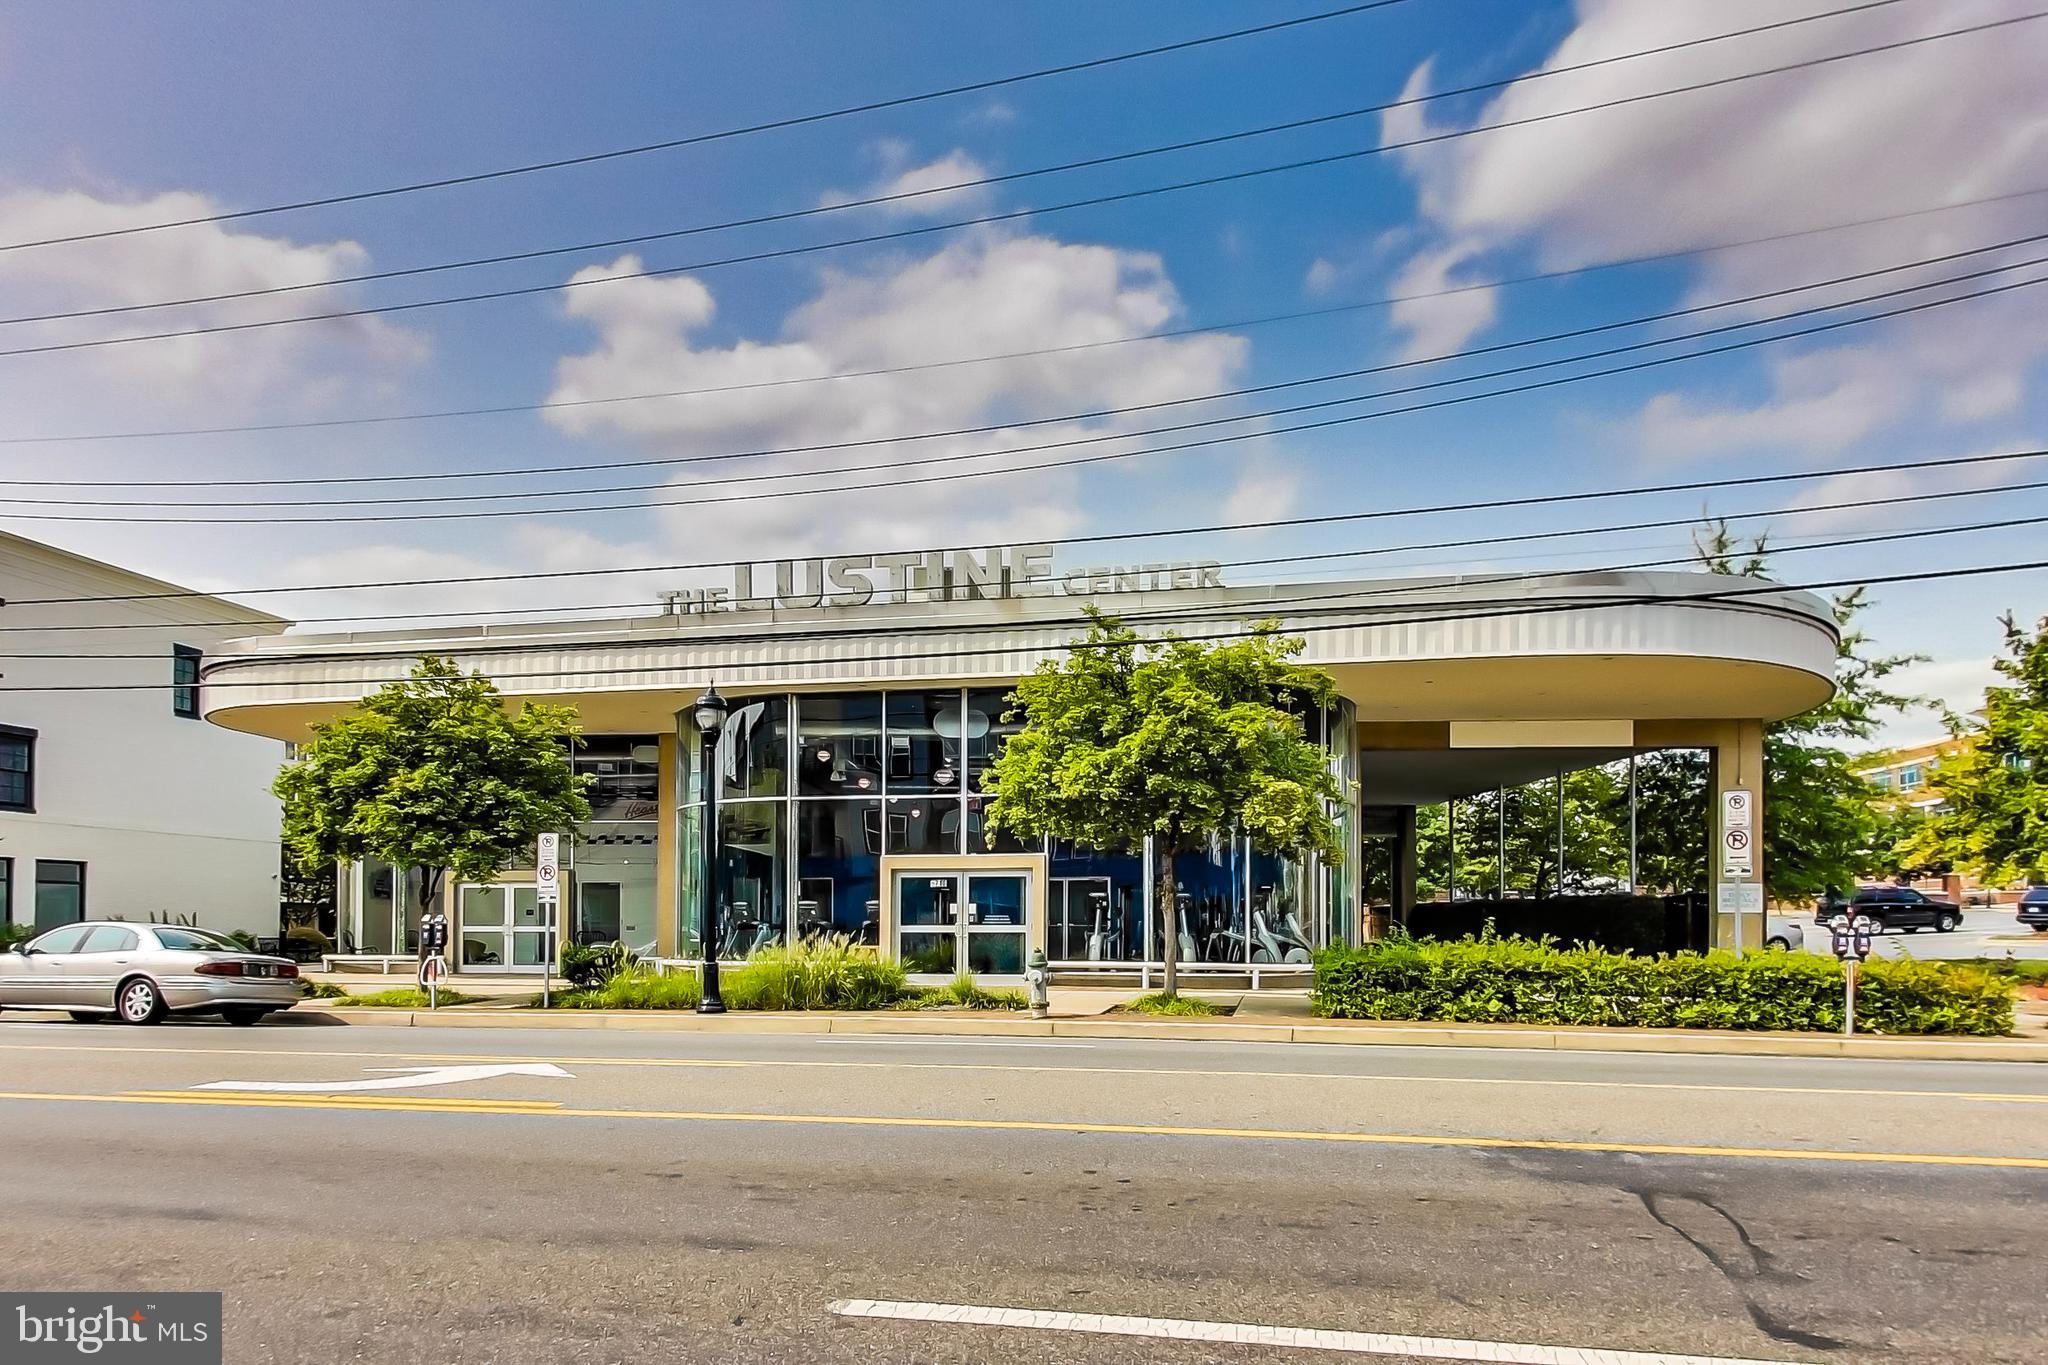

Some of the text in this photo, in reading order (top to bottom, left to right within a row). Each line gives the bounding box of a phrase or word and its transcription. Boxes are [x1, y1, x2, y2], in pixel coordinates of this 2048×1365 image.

[656, 545, 1223, 615] THE LUSTINE CENTER
